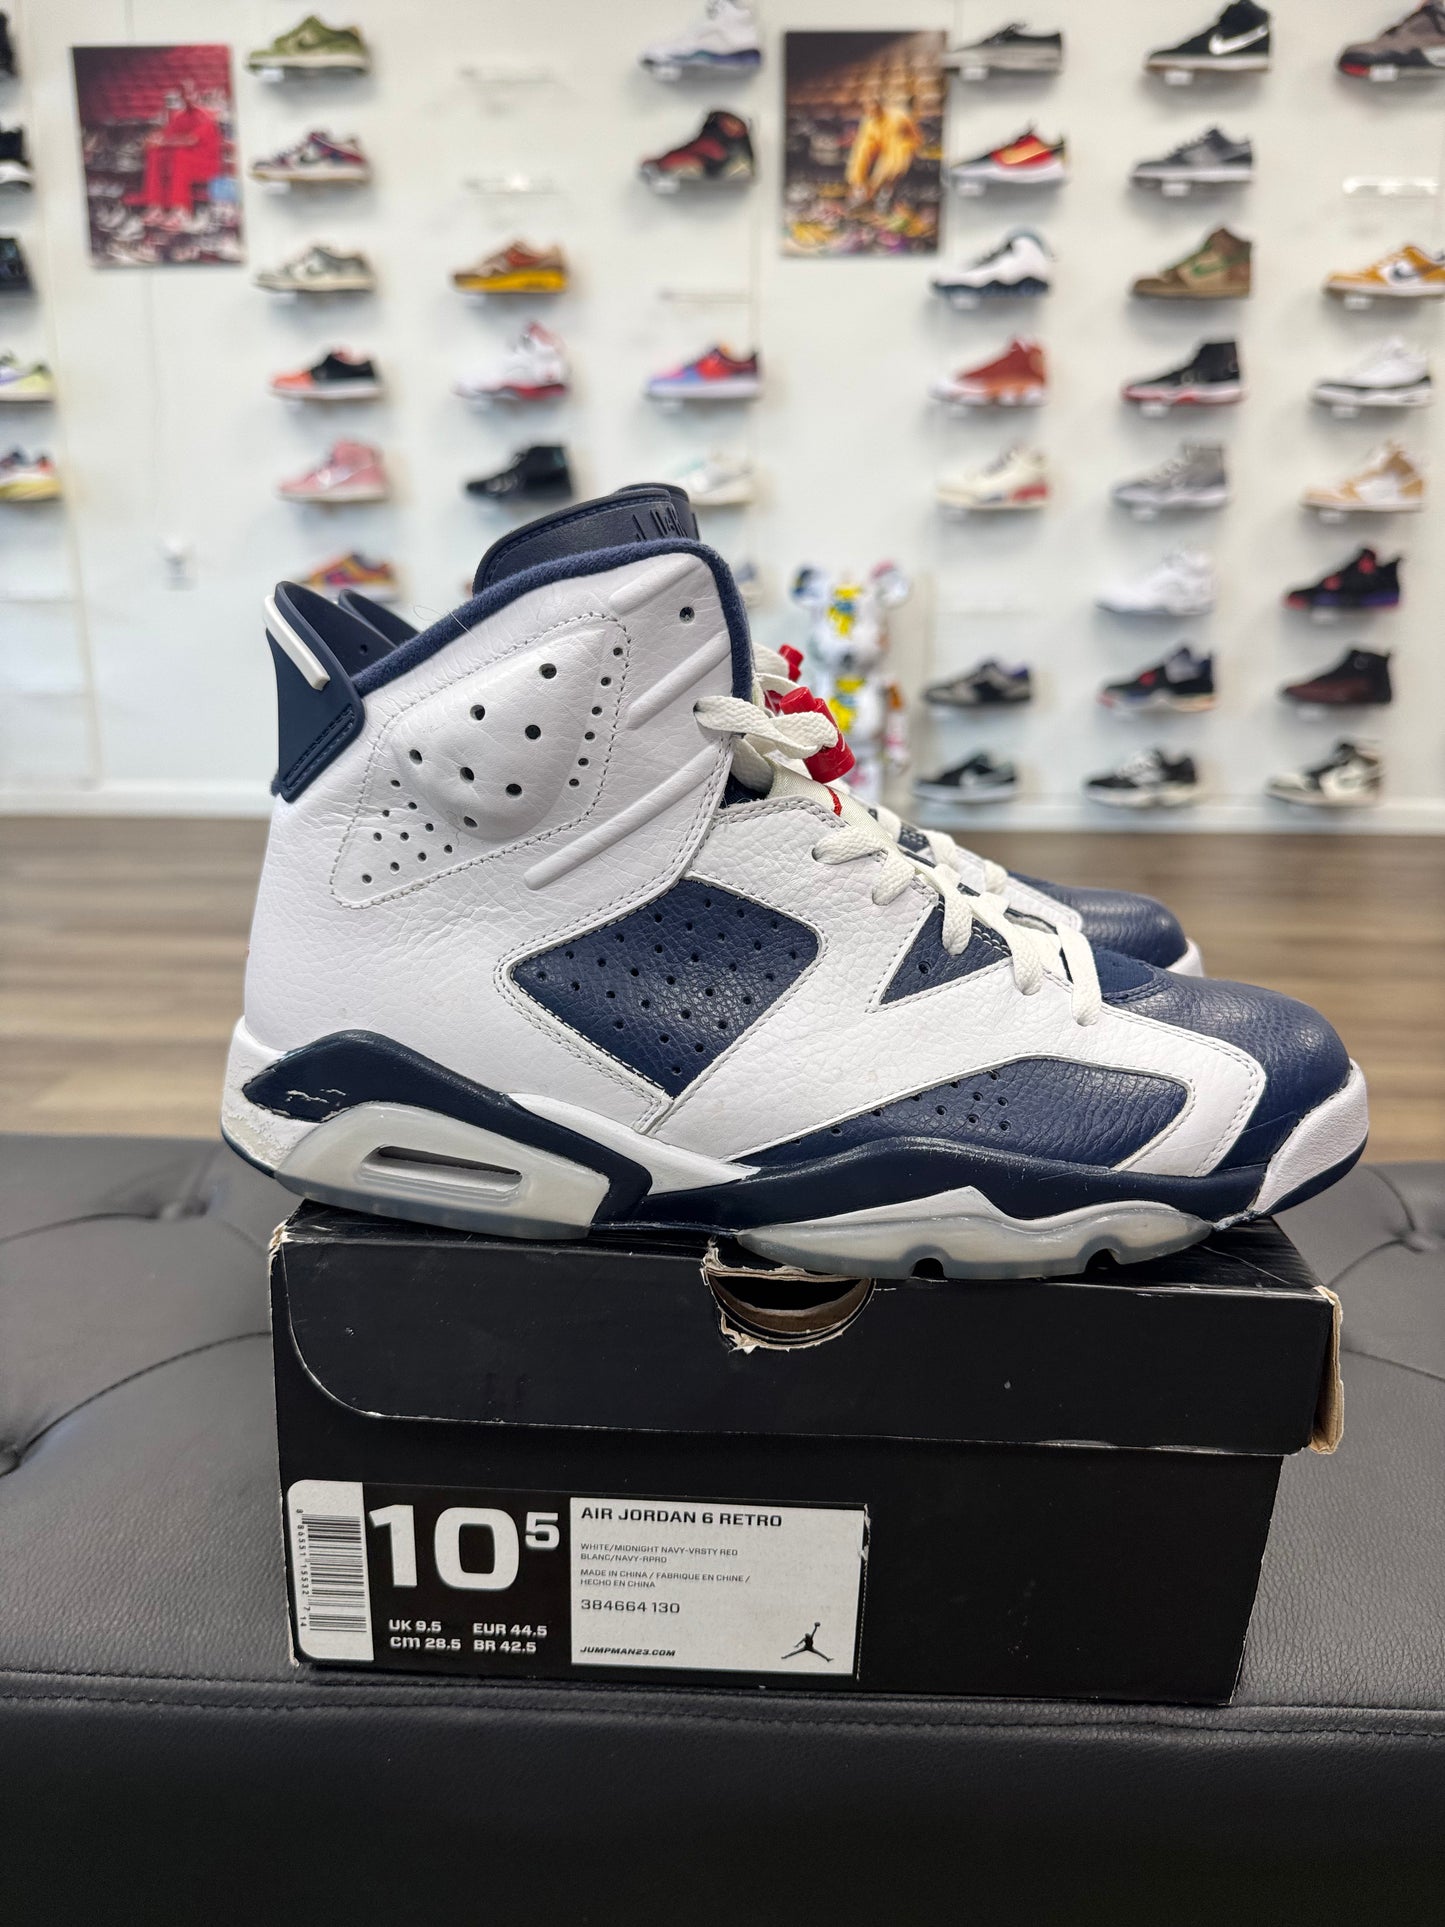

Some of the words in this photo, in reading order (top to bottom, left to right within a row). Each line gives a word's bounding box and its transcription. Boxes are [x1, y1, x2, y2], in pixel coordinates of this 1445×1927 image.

[581, 1507, 613, 1521] AIR
[618, 1509, 697, 1524] JORDAN
[702, 1512, 714, 1525] 6
[719, 1513, 783, 1527] RETRO
[368, 1504, 520, 1591] 10
[525, 1511, 560, 1550] 5
[580, 1543, 660, 1554] WHITE/MIDNIGHT
[661, 1546, 718, 1556] NAVY-VRSTY
[719, 1548, 739, 1557] RED
[580, 1553, 668, 1565] BLANC/NAVY-RPRO
[580, 1569, 607, 1578] MADE
[608, 1570, 618, 1578] IN
[619, 1571, 648, 1580] CHINA
[649, 1572, 654, 1580] /
[656, 1572, 700, 1582] FABRIQUE
[702, 1574, 715, 1582] EN
[716, 1575, 744, 1583] CHINE
[580, 1579, 612, 1588] HECHO
[613, 1580, 626, 1589] EN
[627, 1581, 656, 1589] CHINA
[580, 1599, 647, 1613] 384664
[652, 1601, 681, 1615] 130
[389, 1619, 412, 1632] UK
[415, 1621, 442, 1633] 9.5
[473, 1622, 507, 1636] EUR
[509, 1624, 548, 1637] 44.5
[424, 1638, 462, 1650] 28.5
[474, 1640, 497, 1652] BR
[499, 1641, 537, 1653] 42.5
[580, 1646, 676, 1657] JUMPMAN23.COM
